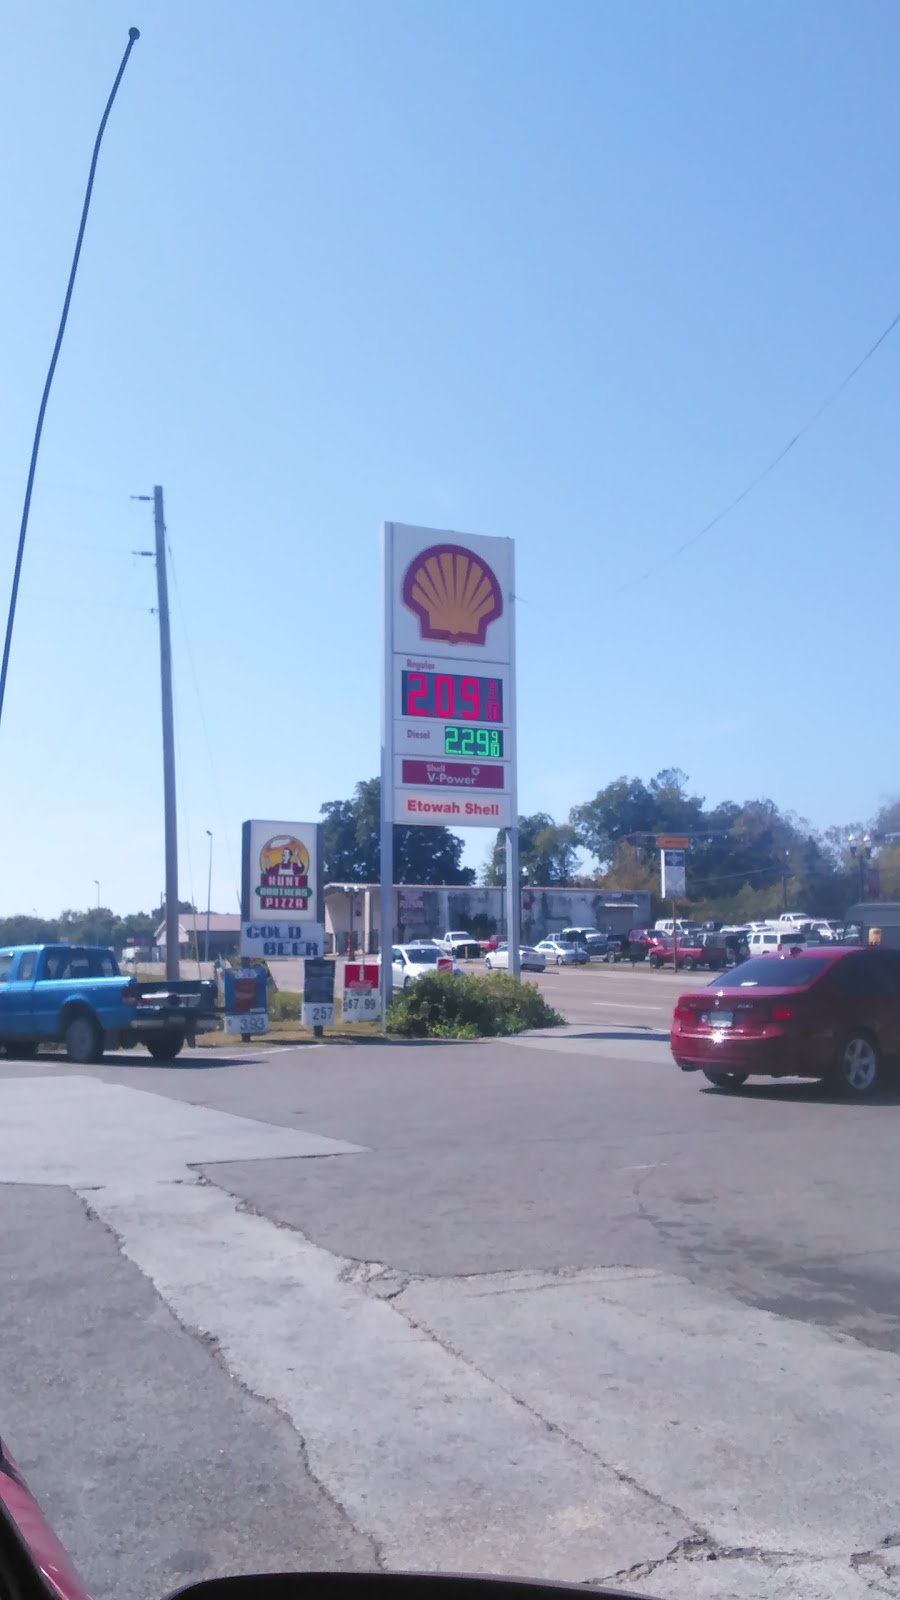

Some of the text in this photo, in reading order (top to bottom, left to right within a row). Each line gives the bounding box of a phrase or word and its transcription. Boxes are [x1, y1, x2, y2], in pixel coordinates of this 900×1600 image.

[407, 659, 435, 671] Regular
[408, 673, 480, 720] 2.09
[407, 730, 431, 740] Diesel
[445, 727, 489, 756] 2.29
[426, 764, 446, 772] Shell
[427, 773, 477, 784] V-Power
[407, 799, 499, 816] Etowah Shell
[268, 876, 300, 886] HUNT
[260, 887, 308, 897] BROTHERS
[265, 897, 304, 909] PIZZA
[246, 925, 302, 939] COLD
[263, 941, 319, 956] BEER
[312, 1007, 333, 1021] 257
[240, 1017, 265, 1031] 393
